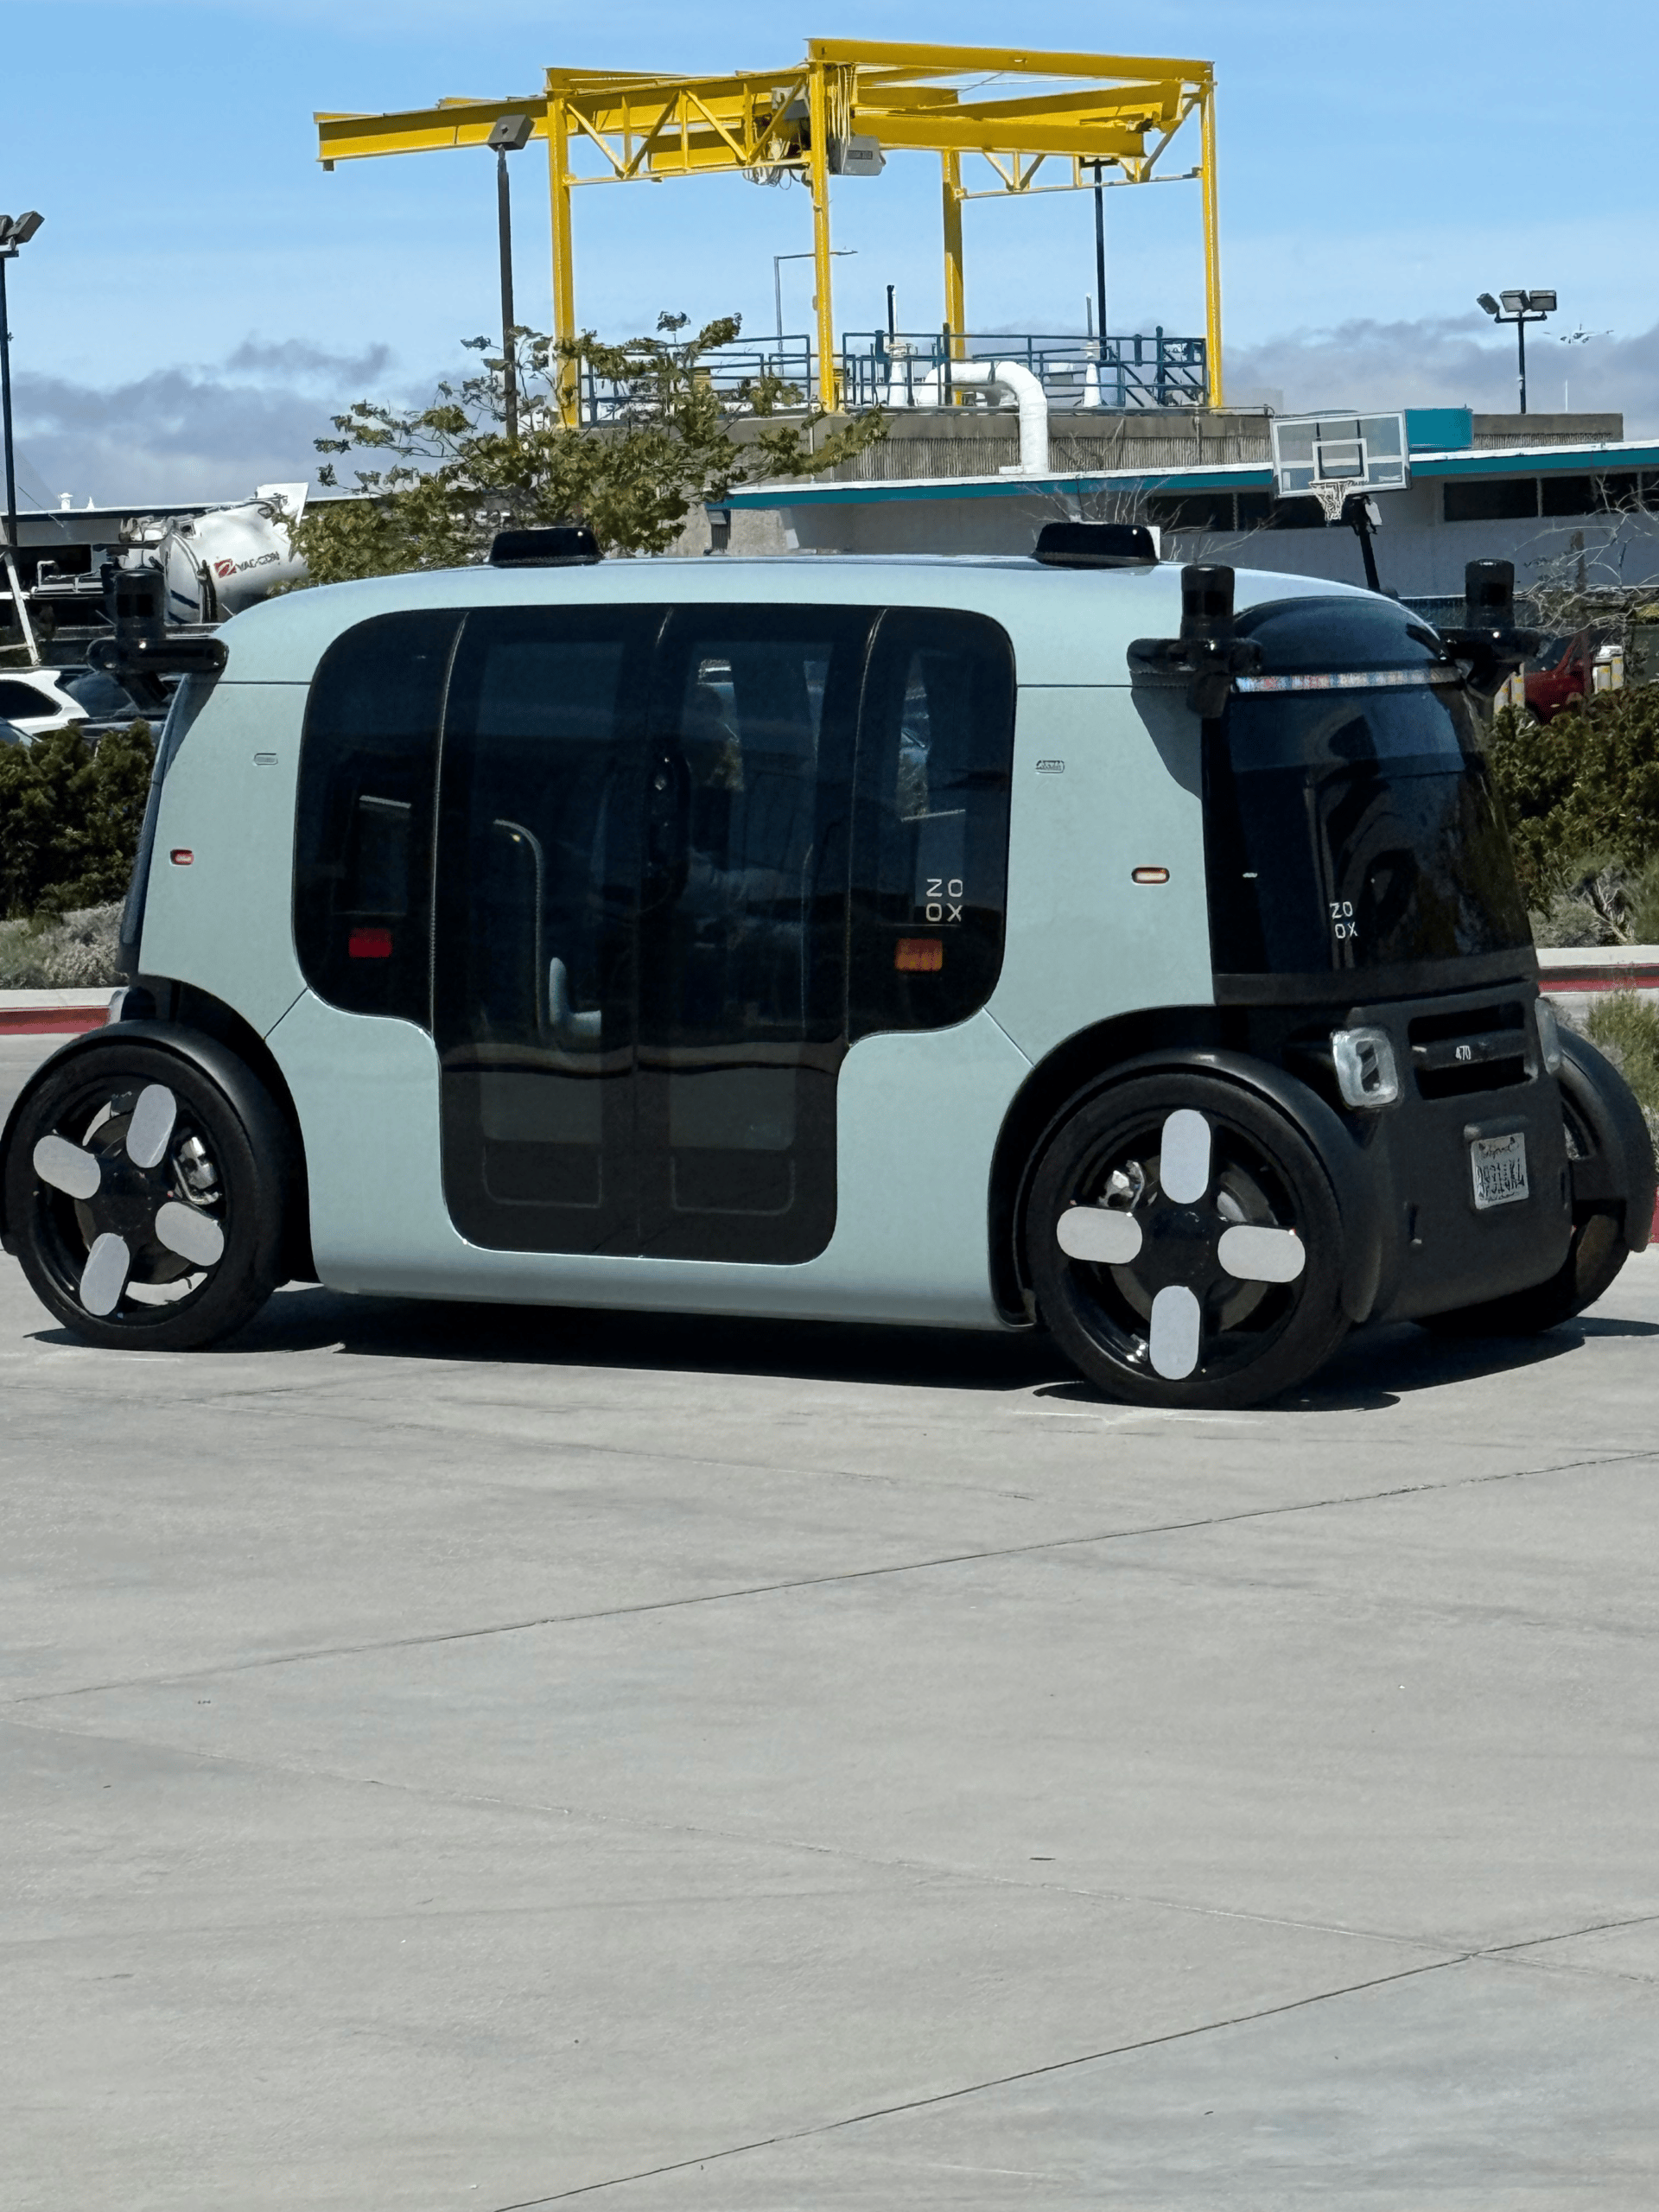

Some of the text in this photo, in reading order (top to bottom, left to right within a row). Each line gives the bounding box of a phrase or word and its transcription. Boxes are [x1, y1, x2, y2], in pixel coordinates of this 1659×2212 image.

[925, 878, 963, 898] ZO
[925, 902, 963, 922] OX
[1329, 901, 1353, 919] ZO
[1335, 921, 1358, 939] OX
